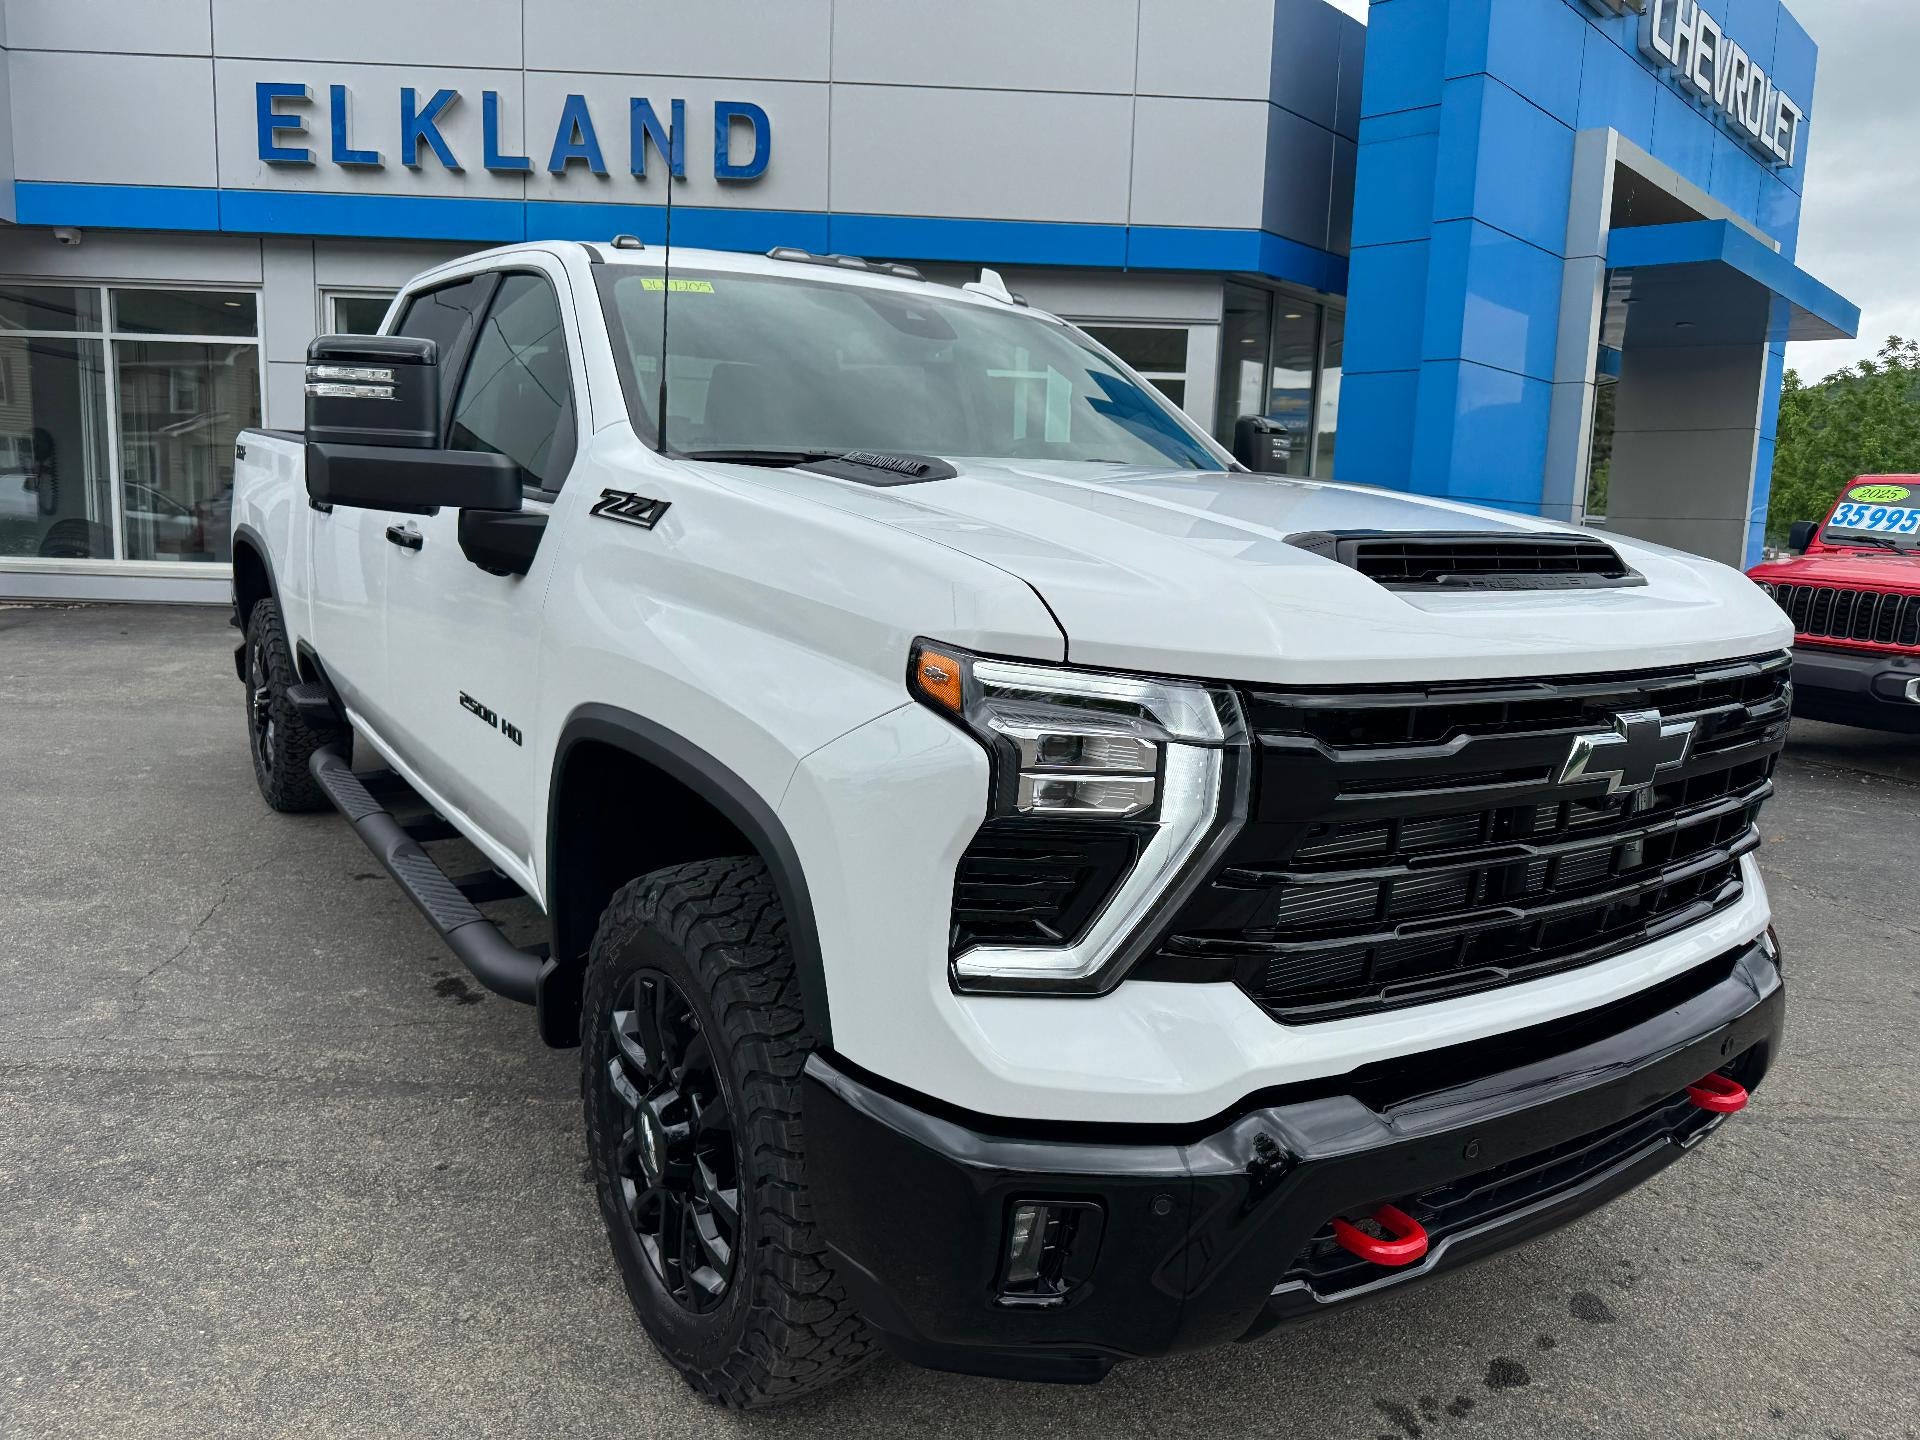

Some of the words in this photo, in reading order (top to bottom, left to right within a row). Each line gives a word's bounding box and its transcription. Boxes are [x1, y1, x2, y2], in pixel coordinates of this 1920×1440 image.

[1651, 0, 1803, 168] CHEVROLET
[255, 81, 772, 184] ELKLAND
[873, 455, 922, 476] DURAMAX
[589, 488, 672, 531] Z71
[1858, 488, 1902, 499] 2025
[1832, 504, 1920, 532] 35995
[459, 690, 498, 728] 2500
[501, 718, 523, 747] HD
